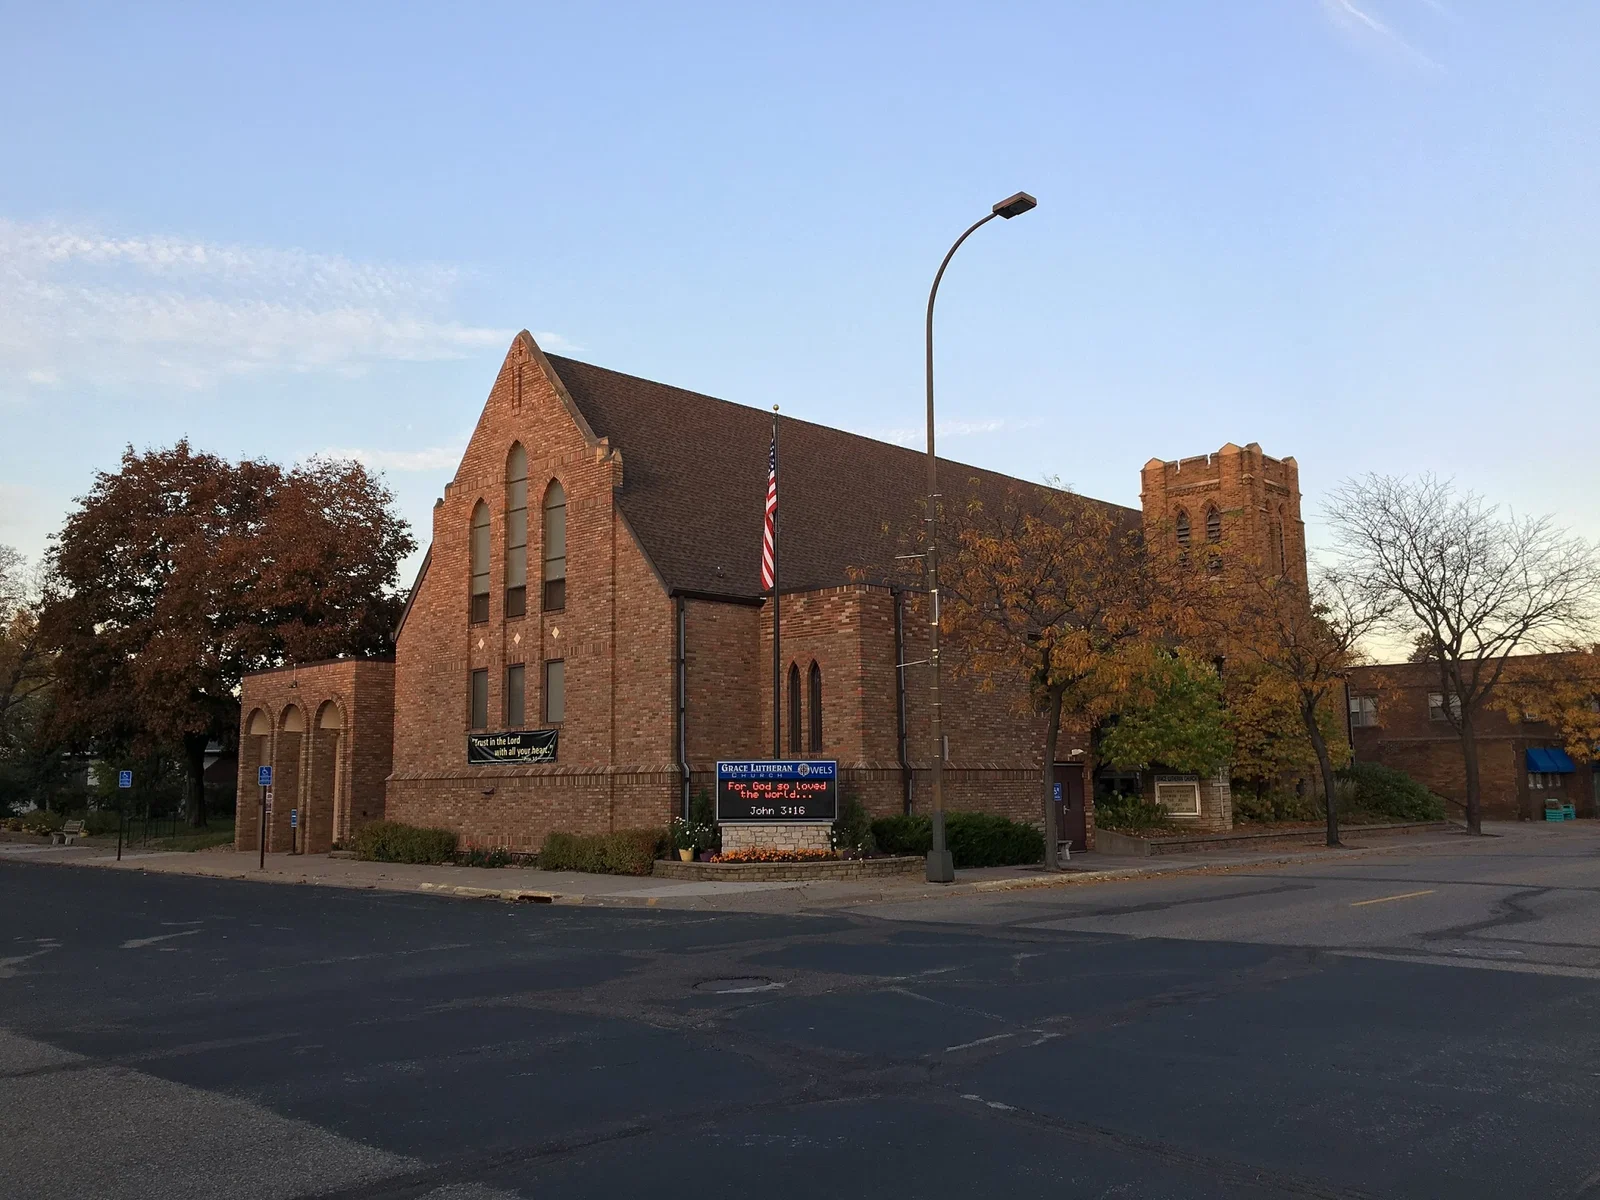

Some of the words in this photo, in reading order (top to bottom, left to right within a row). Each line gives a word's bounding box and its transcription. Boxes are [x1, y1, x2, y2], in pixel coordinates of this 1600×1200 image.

[490, 737, 495, 746] in
[497, 737, 506, 745] the
[508, 736, 520, 745] Lord
[494, 747, 507, 756] with
[517, 748, 530, 757] your
[721, 763, 748, 772] GRACE
[750, 763, 793, 772] LUTHERAN
[810, 766, 832, 774] WELS
[728, 782, 747, 791] For
[752, 782, 772, 791] God
[796, 781, 827, 791] loved
[740, 790, 760, 799] the
[764, 790, 812, 799] world...
[749, 806, 775, 816] John
[780, 806, 806, 815] 3:16
